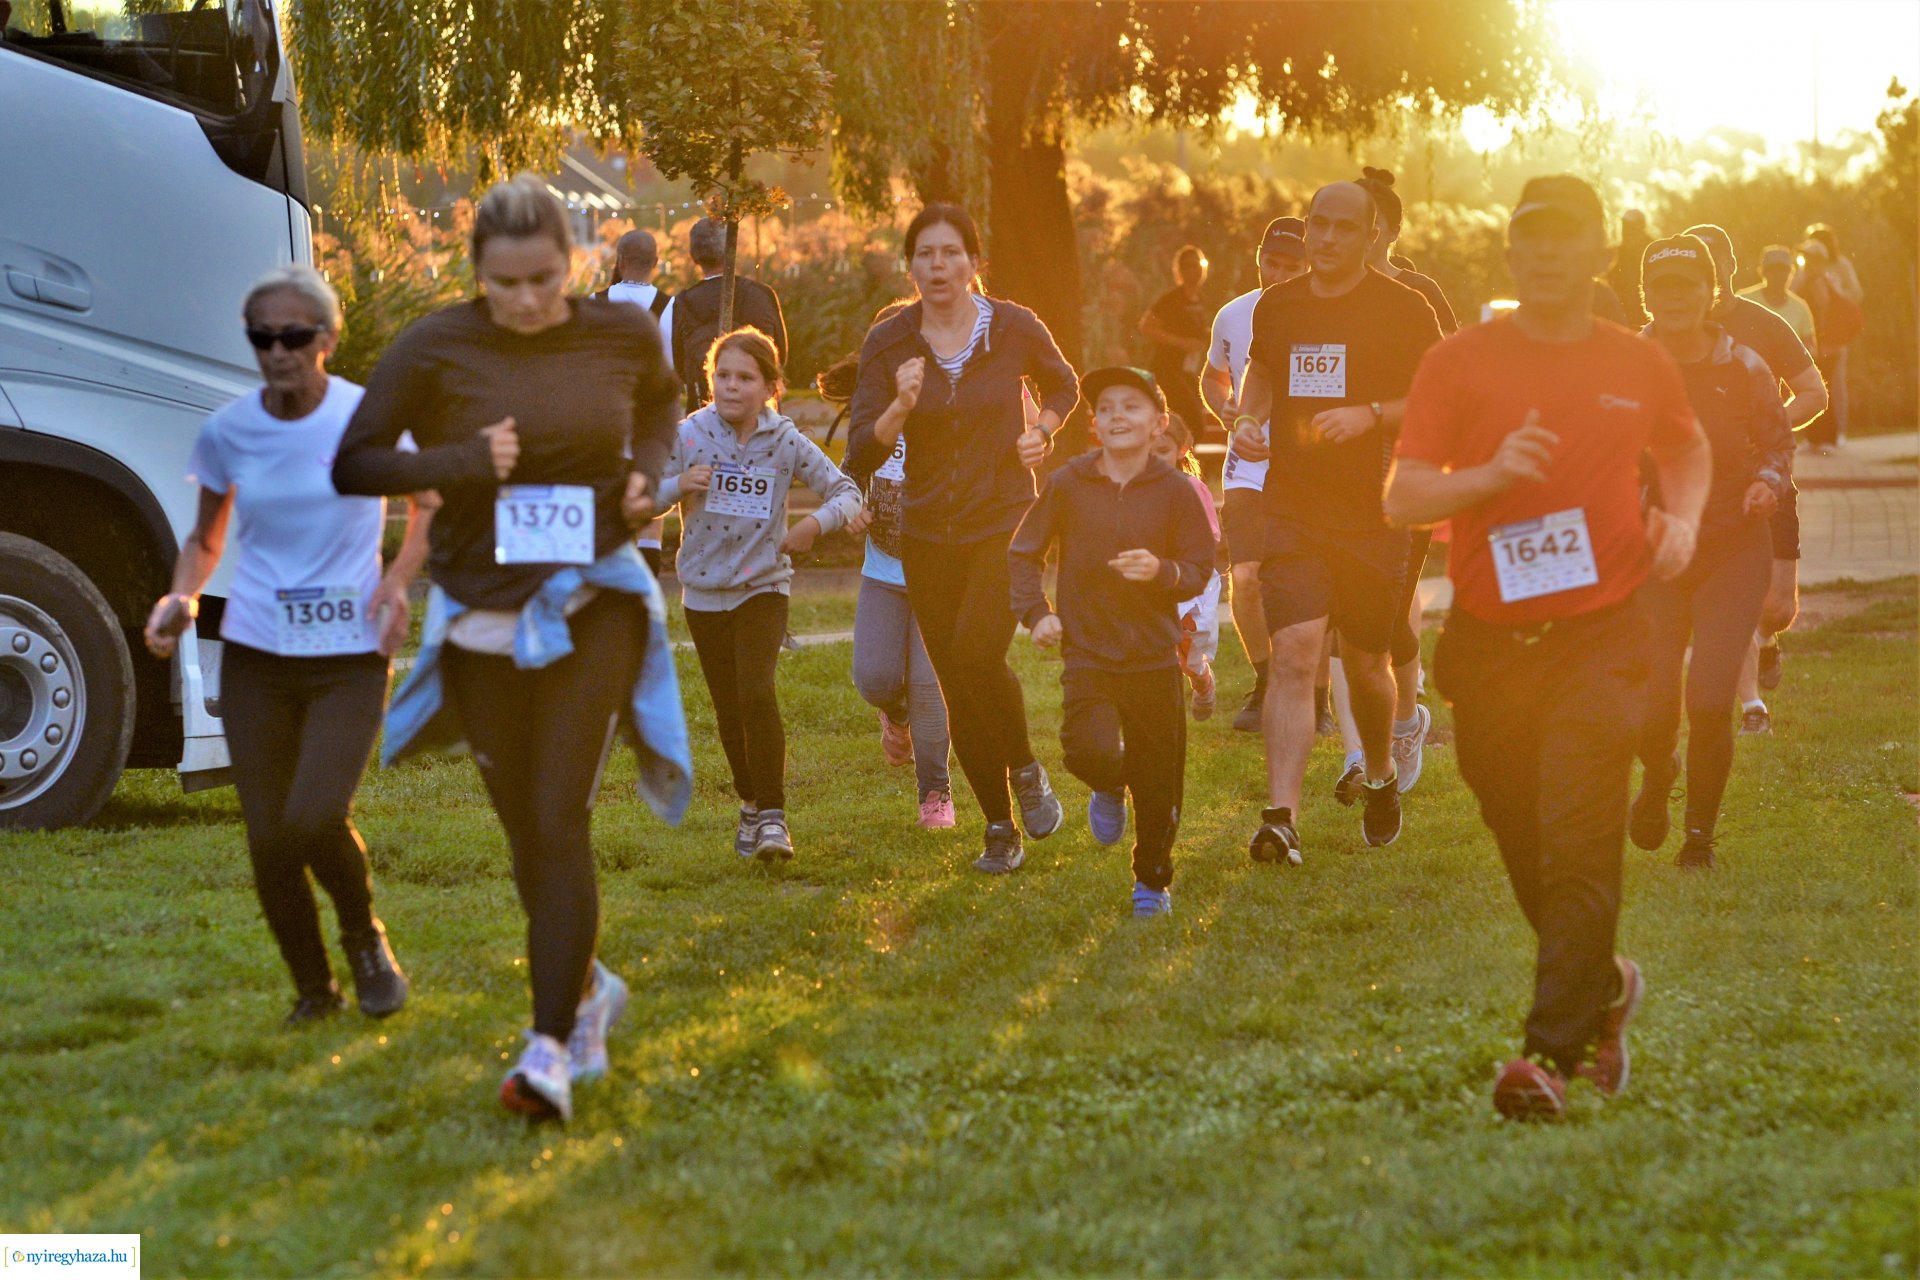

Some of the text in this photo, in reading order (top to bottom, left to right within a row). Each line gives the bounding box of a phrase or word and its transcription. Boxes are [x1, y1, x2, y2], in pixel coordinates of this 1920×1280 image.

[1648, 248, 1697, 263] adidas
[1296, 355, 1340, 374] 1667
[715, 474, 768, 496] 1659
[506, 503, 583, 528] 1370
[1502, 529, 1581, 565] 1642
[285, 599, 354, 624] 1308
